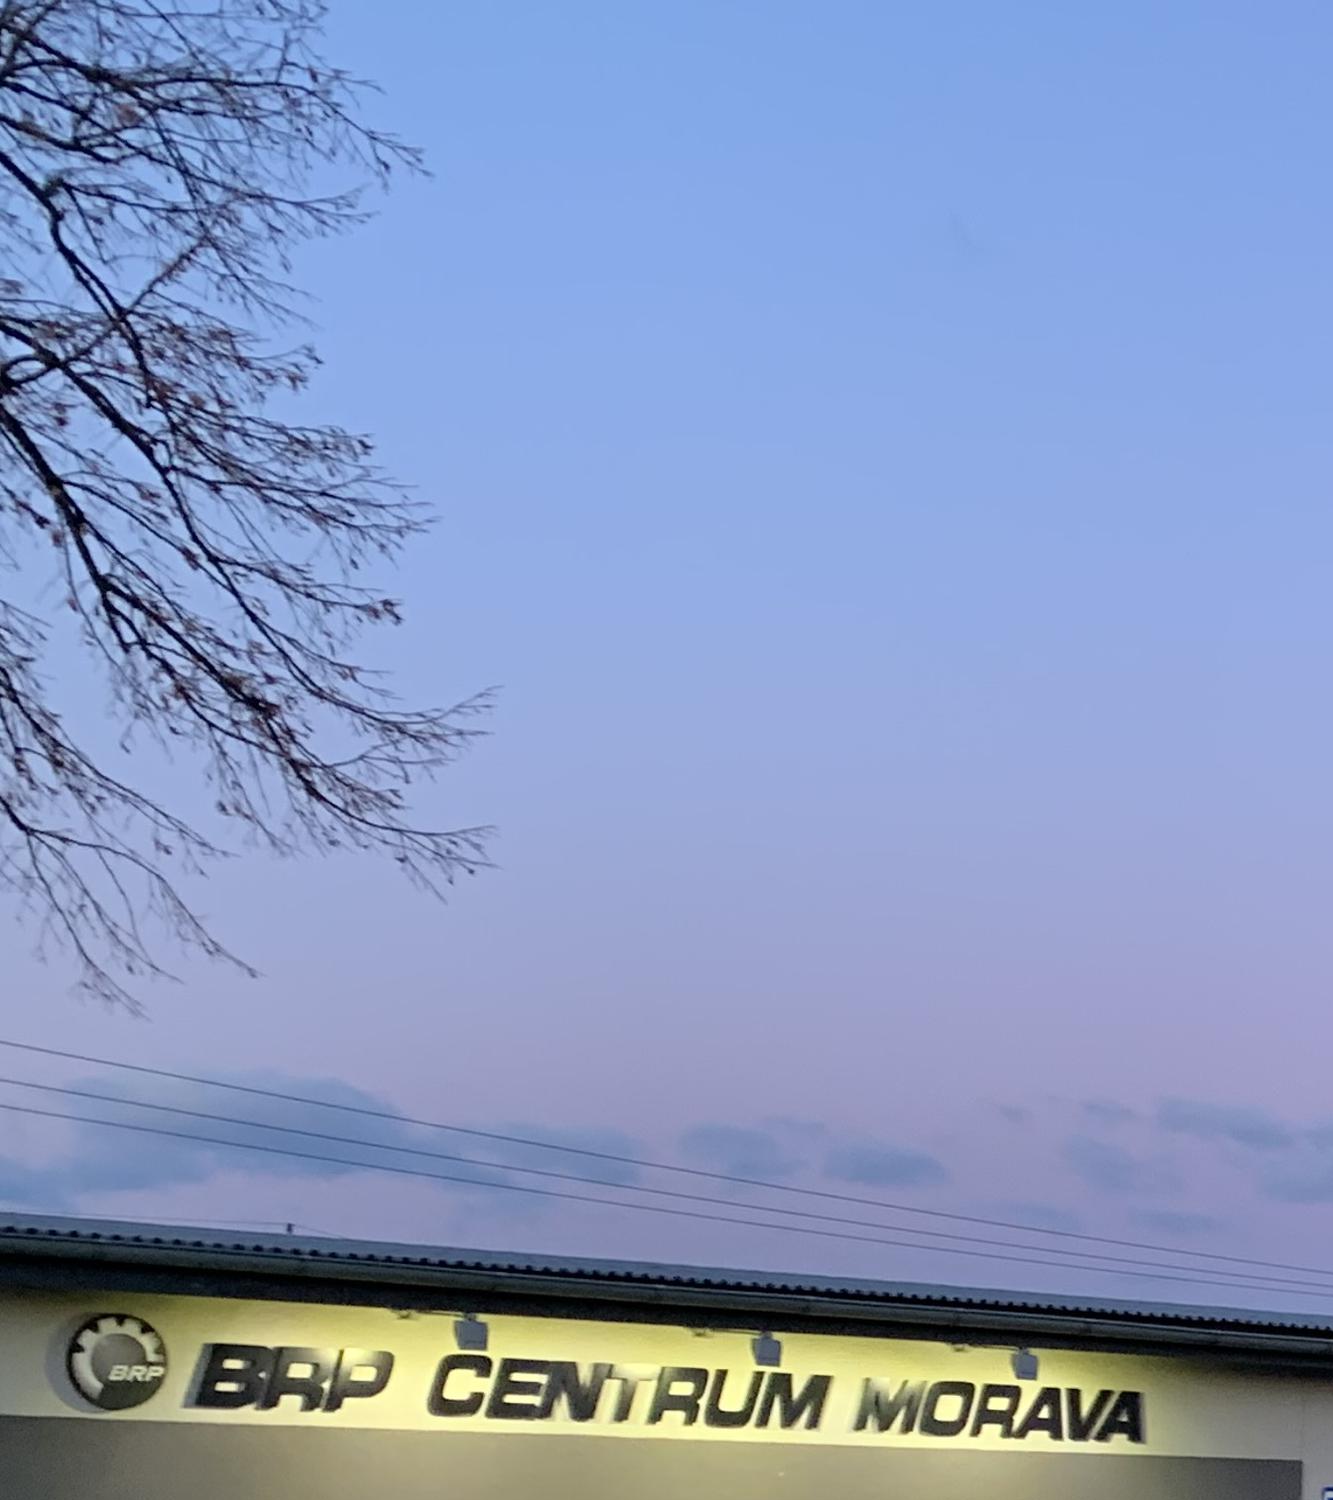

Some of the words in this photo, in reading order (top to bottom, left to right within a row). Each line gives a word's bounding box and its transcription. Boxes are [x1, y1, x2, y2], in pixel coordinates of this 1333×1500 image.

[108, 1365, 165, 1383] BRP
[195, 1342, 395, 1413] BRP
[427, 1353, 832, 1430] CENTRUM
[852, 1377, 1146, 1444] MORAVA
